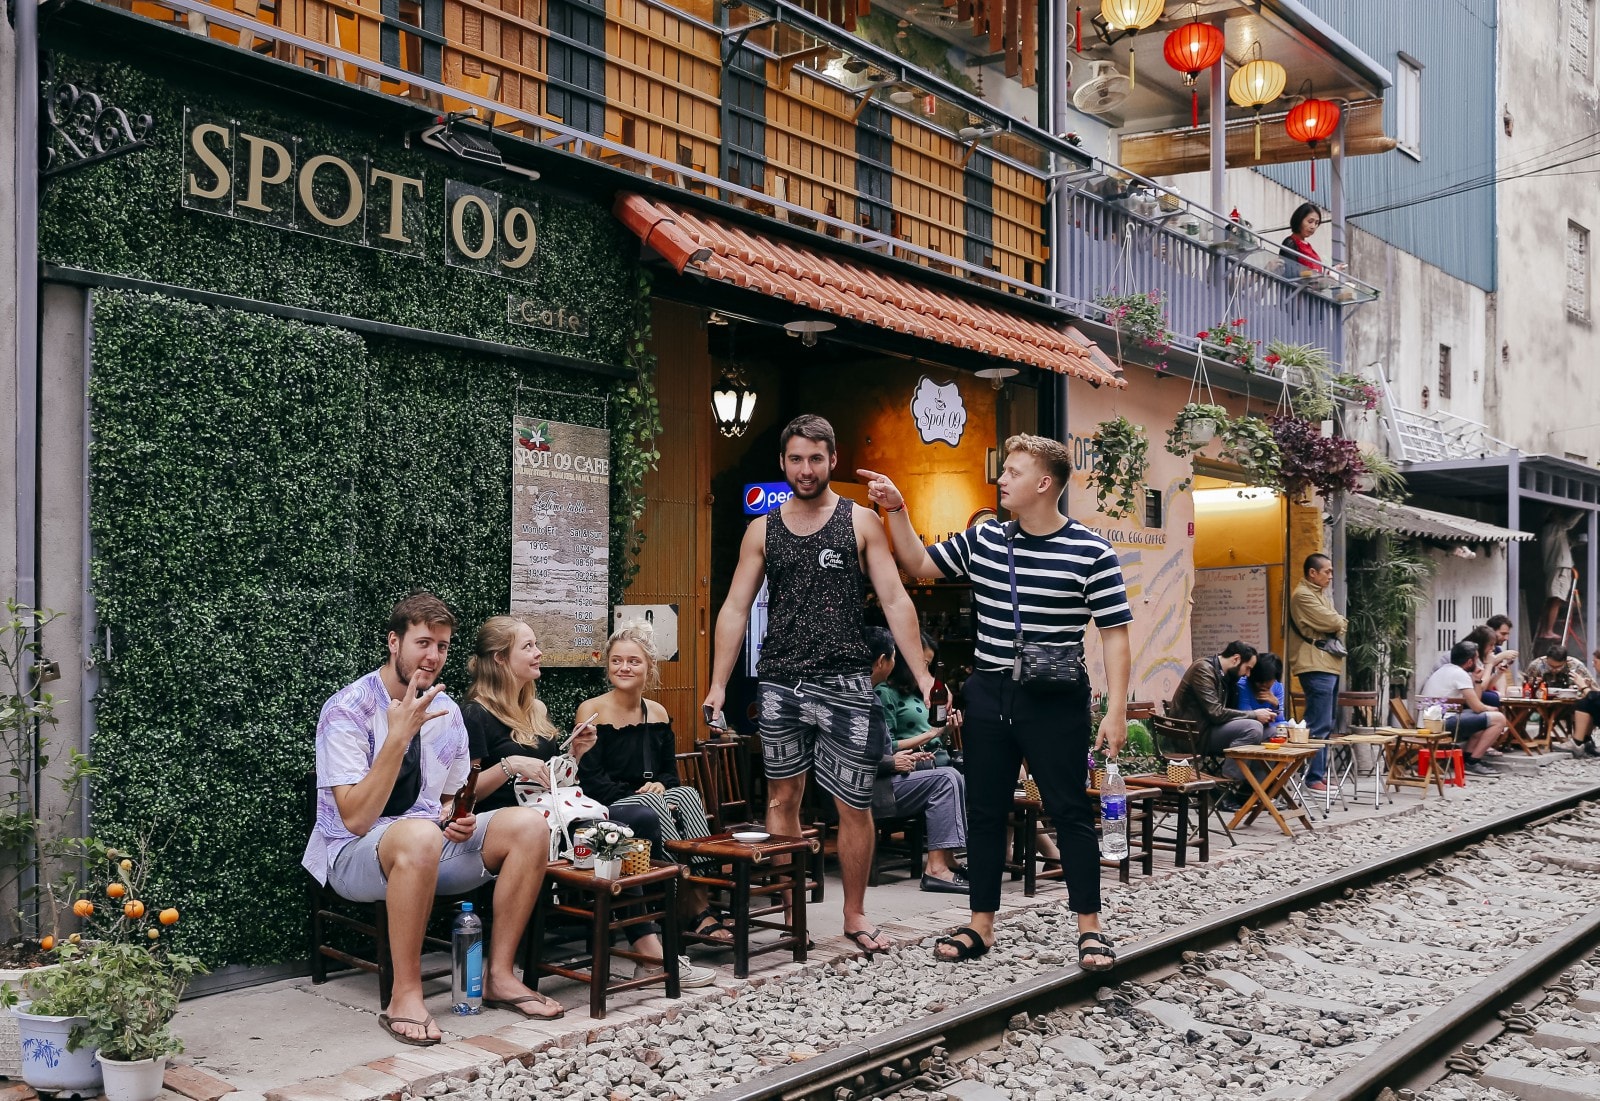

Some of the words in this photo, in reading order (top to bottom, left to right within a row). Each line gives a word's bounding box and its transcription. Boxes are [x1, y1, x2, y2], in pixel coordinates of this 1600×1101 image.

[189, 123, 424, 245] SPOT
[450, 195, 538, 269] 09
[520, 300, 580, 333] Cafe
[920, 407, 946, 430] Spot
[948, 410, 961, 430] 09
[515, 447, 552, 469] SPOT
[553, 452, 571, 471] 09
[574, 455, 609, 476] CAFE
[569, 527, 582, 538] Sat
[1129, 531, 1143, 544] EGG
